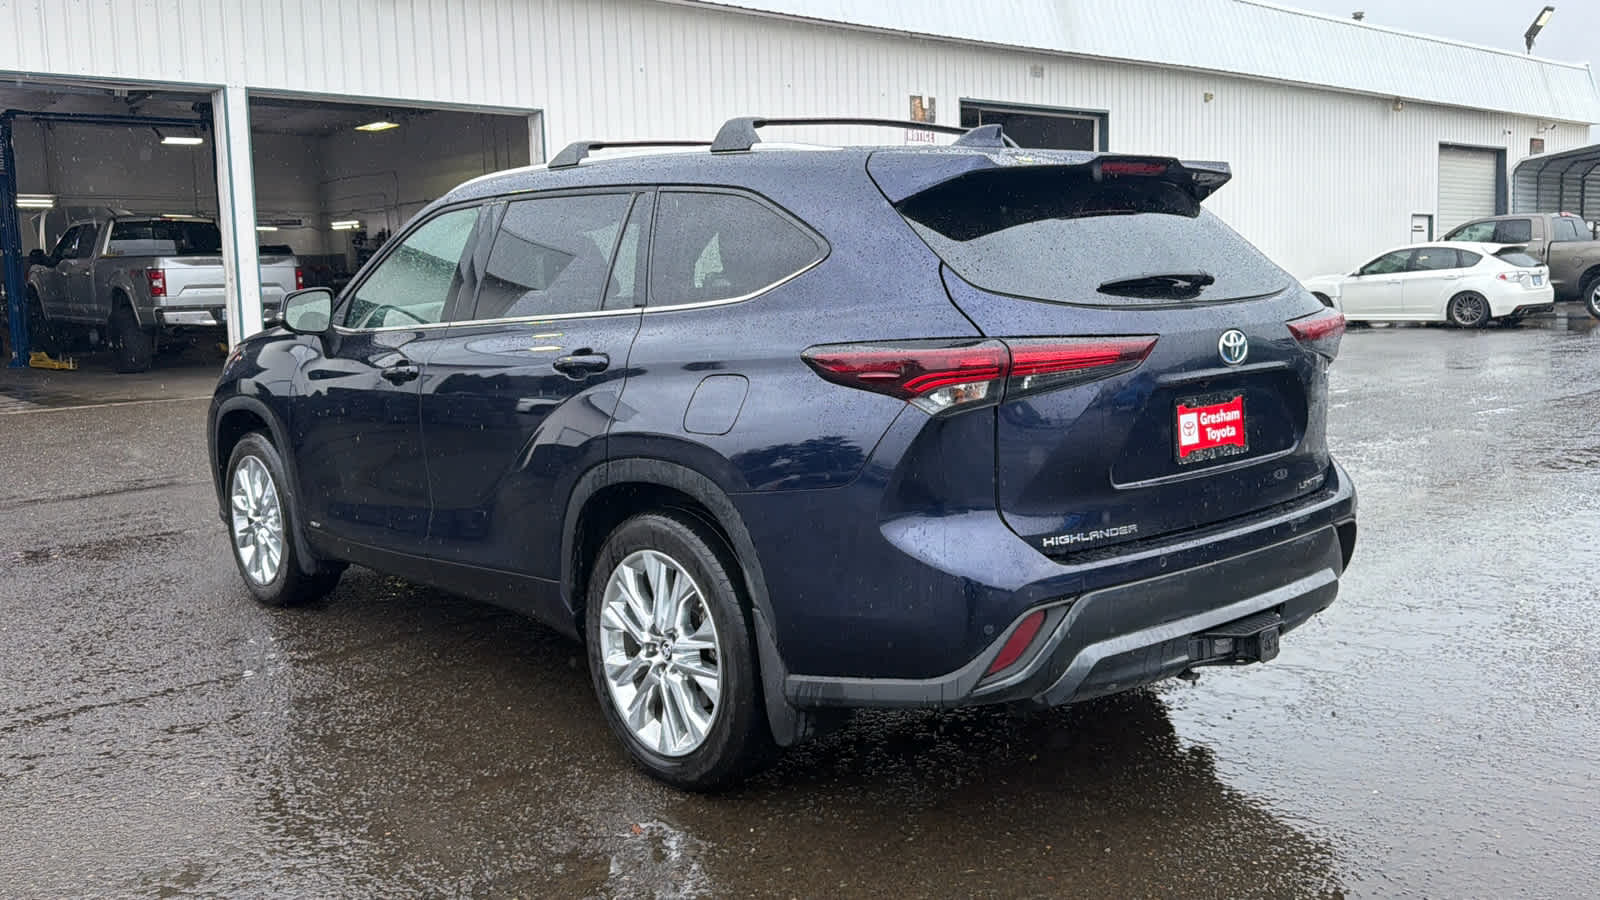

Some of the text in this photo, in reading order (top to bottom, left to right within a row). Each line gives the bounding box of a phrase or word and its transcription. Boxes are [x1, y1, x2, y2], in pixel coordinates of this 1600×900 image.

[1200, 409, 1240, 425] Gresham
[1205, 425, 1236, 442] Toyota
[1042, 523, 1138, 547] HIGHLANDER
